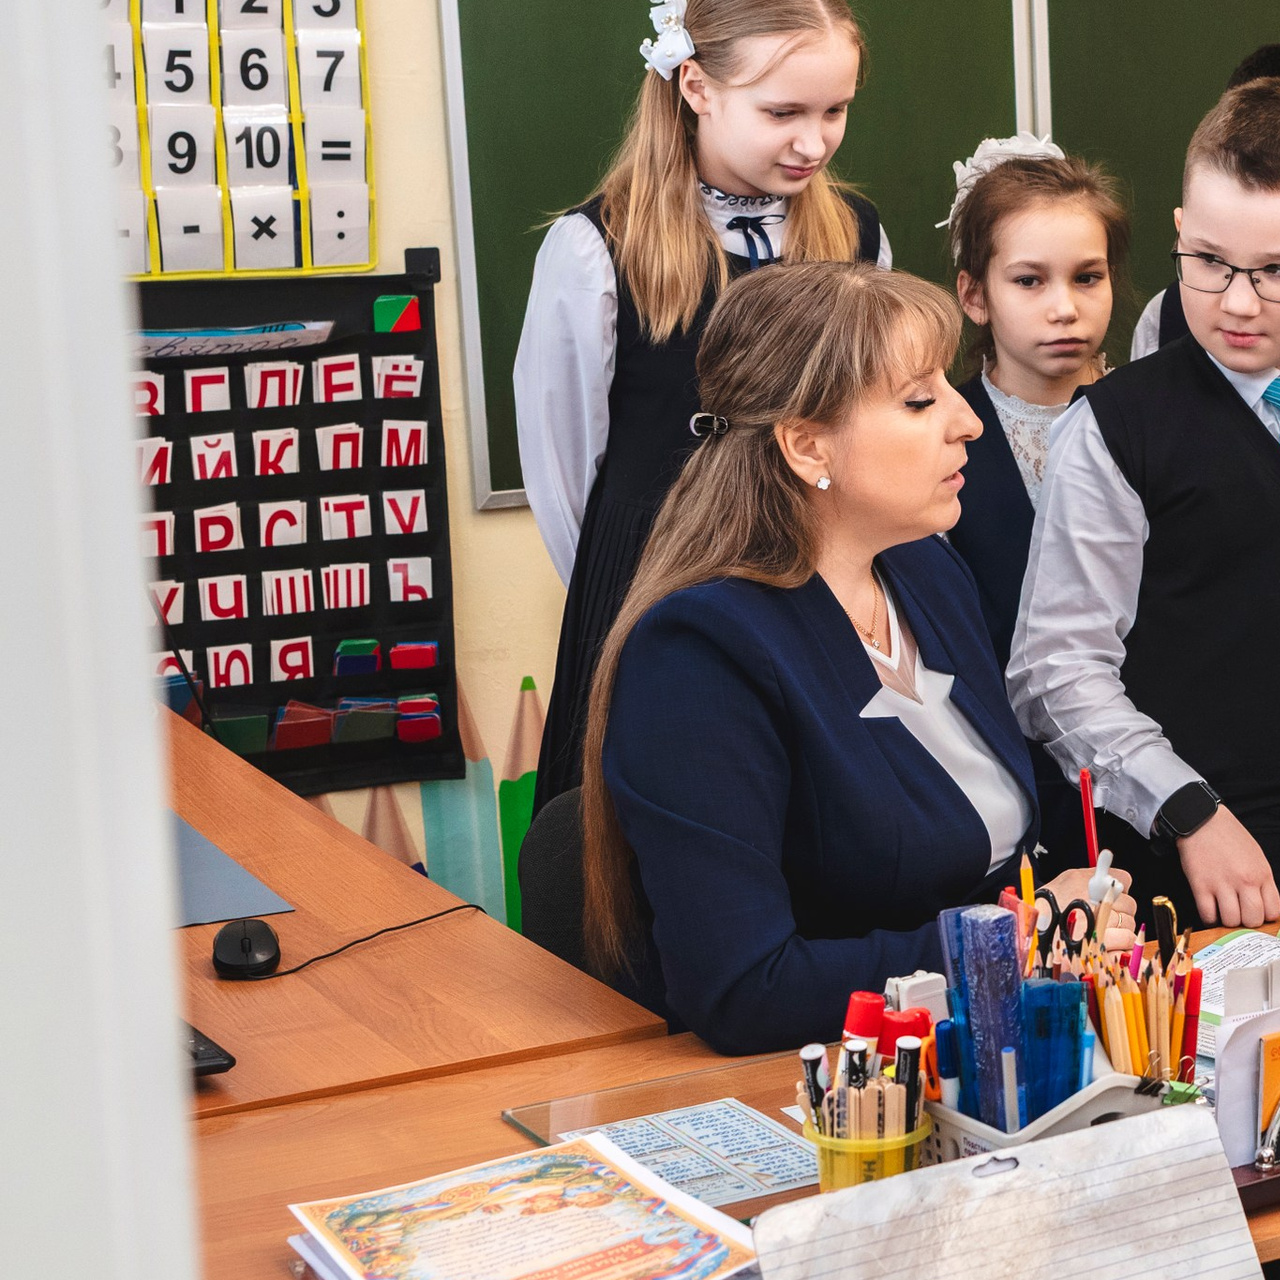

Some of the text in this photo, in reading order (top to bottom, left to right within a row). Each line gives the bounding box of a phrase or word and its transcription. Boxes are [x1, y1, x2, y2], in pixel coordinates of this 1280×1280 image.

[164, 48, 345, 93] 5 6 7
[167, 126, 281, 174] 9 10
[197, 428, 422, 479] Й К М
[200, 515, 234, 552] Р
[333, 501, 365, 538] Т
[208, 580, 244, 618] Ч
[279, 641, 311, 681] Я
